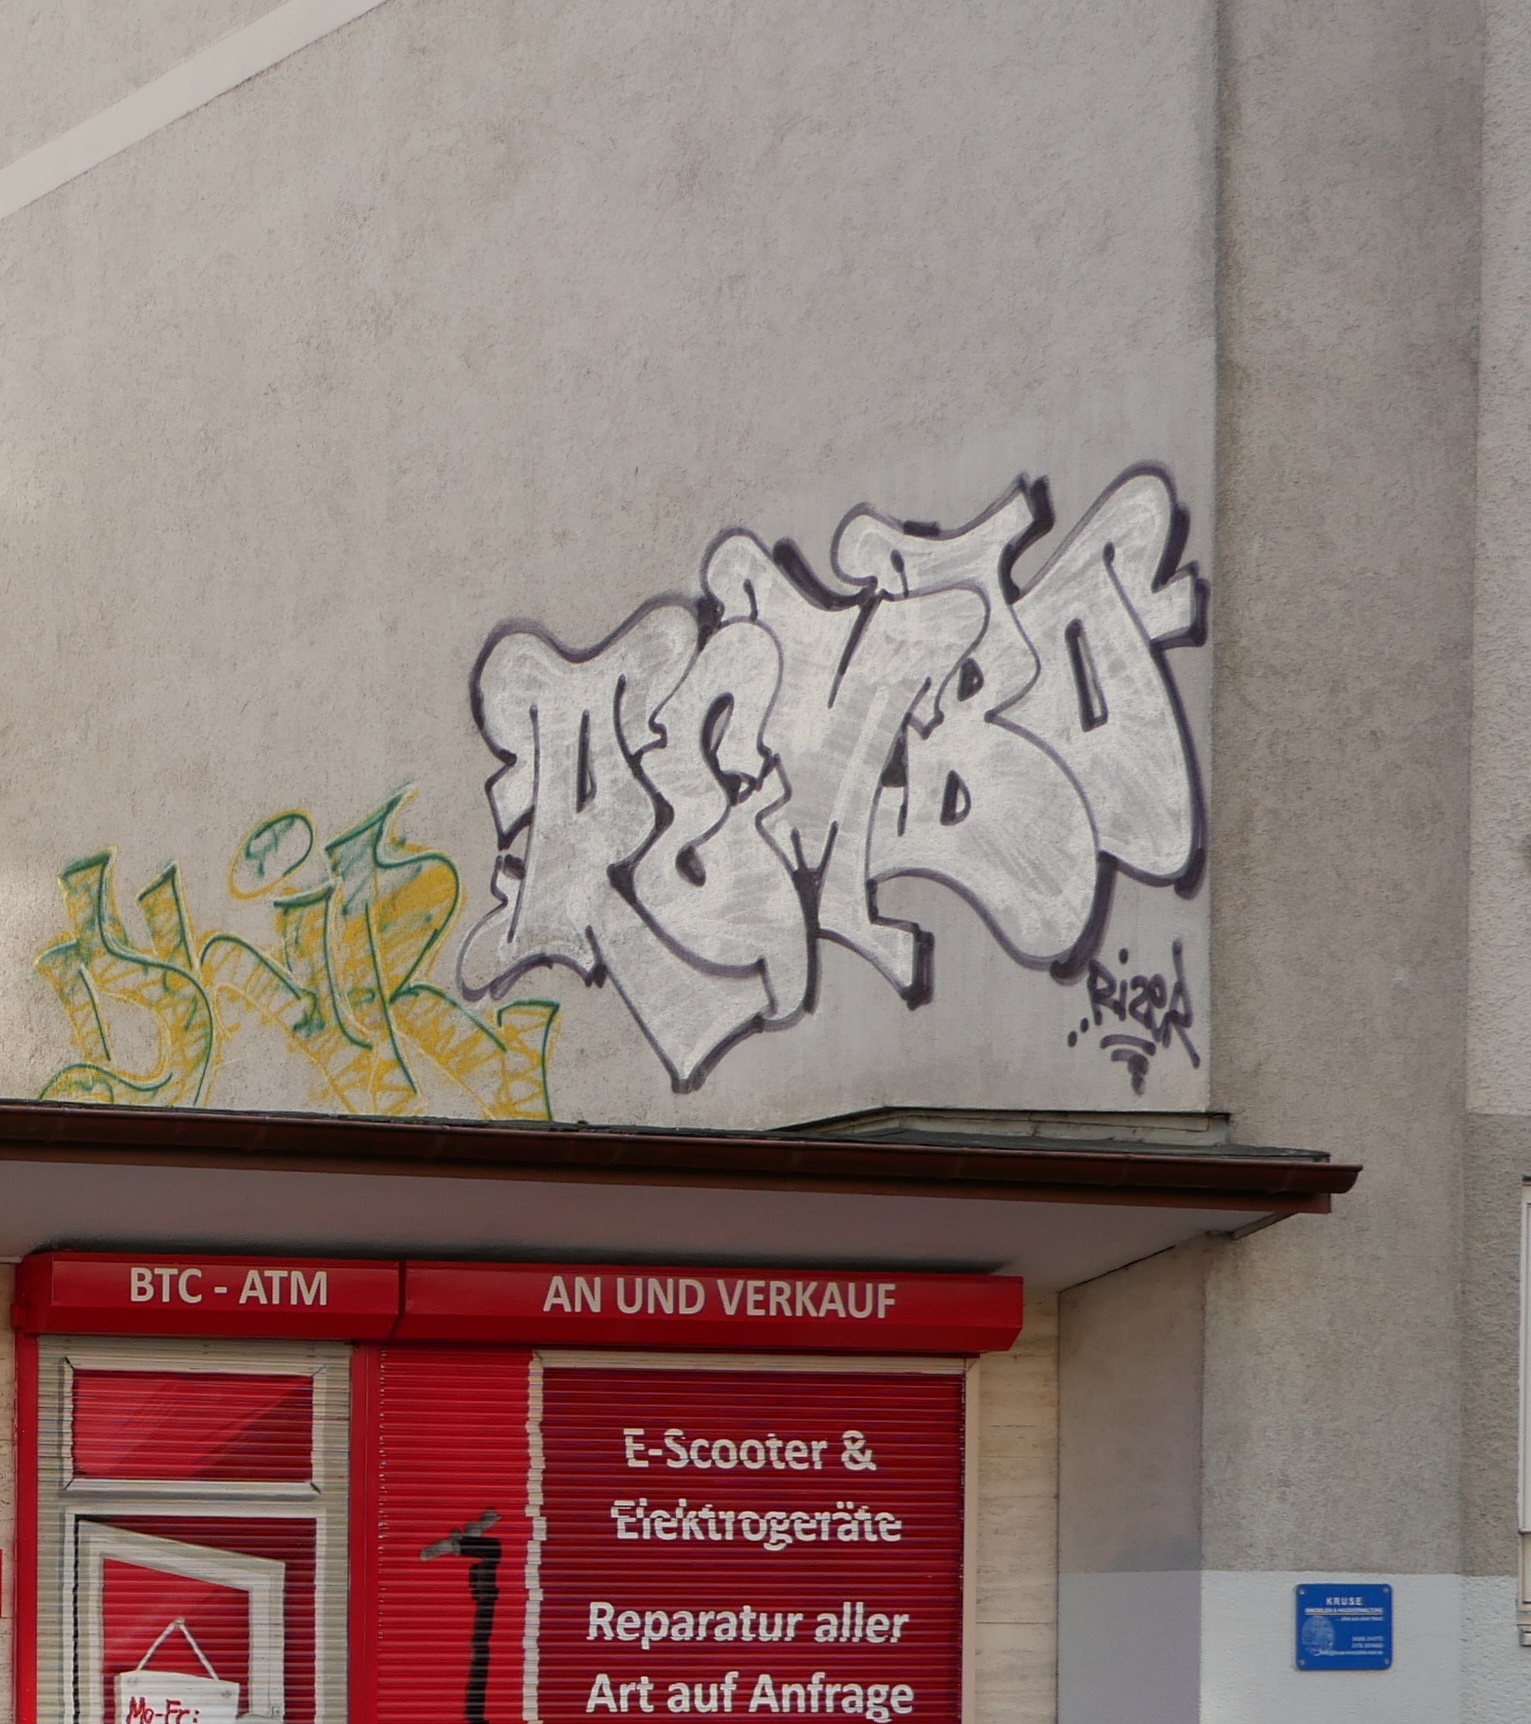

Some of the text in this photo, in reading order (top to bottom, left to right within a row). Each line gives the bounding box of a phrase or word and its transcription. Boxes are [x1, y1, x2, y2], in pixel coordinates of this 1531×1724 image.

[130, 1267, 203, 1304] BTC
[238, 1270, 328, 1306] ATM
[542, 1276, 896, 1319] AN UND VERKAUF
[622, 1428, 878, 1472] E-Scooter &
[609, 1497, 903, 1552] Elektrogeräte
[1325, 1596, 1363, 1606] KRUSE
[585, 1601, 911, 1651] Reparatur aller
[584, 1671, 915, 1724] Art auf Anfrage
